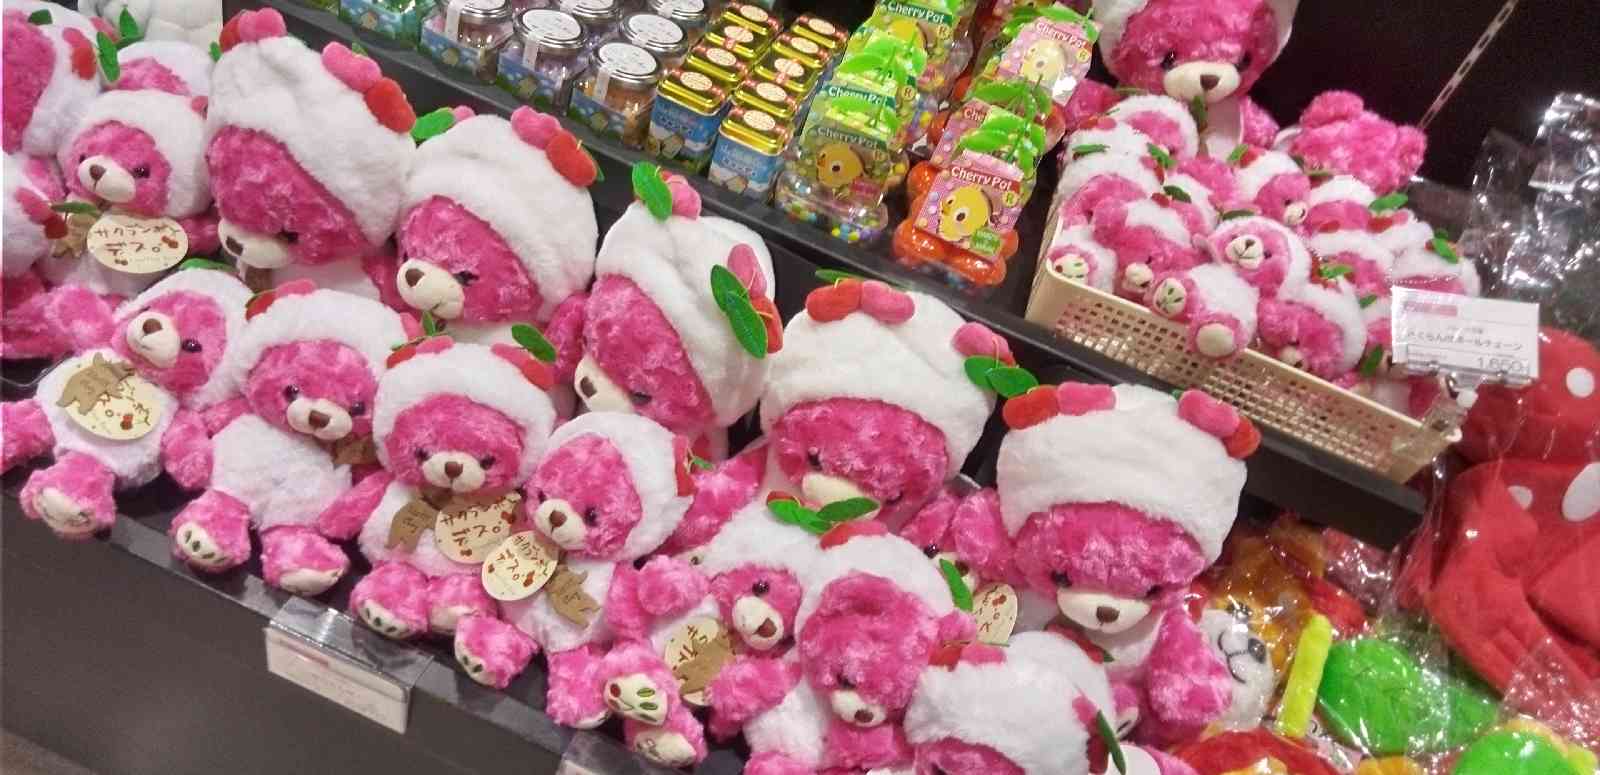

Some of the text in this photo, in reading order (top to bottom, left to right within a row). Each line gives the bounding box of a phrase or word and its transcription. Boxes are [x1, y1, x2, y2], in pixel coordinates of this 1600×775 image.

[888, 0, 945, 24] Cherry Pot
[817, 127, 879, 152] Cherry Pot
[951, 166, 1013, 192] Cherry Pot
